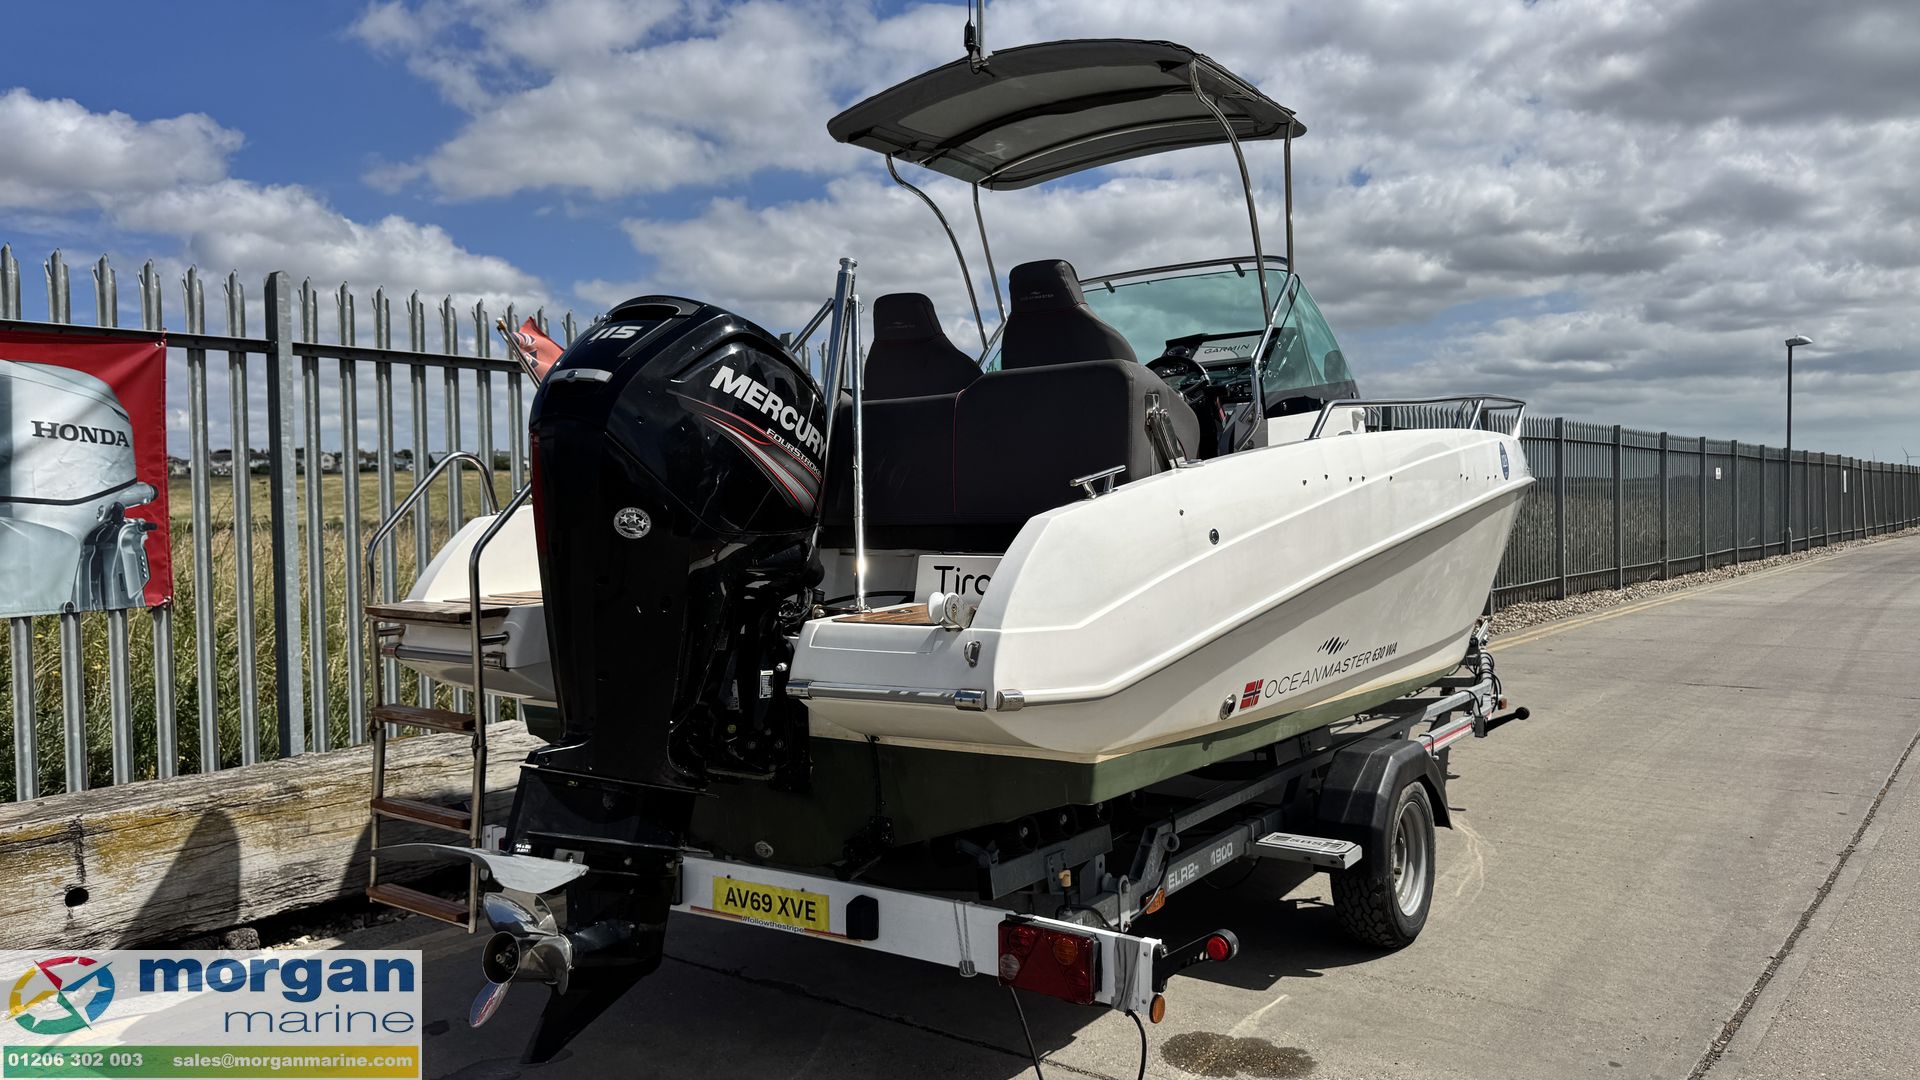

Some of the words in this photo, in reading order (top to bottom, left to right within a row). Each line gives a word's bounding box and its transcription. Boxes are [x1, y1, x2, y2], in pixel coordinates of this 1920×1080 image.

[589, 325, 643, 341] 115
[1204, 344, 1250, 354] GARMIN
[710, 365, 827, 461] MERCURY
[31, 420, 130, 448] HONDA
[1265, 651, 1370, 698] OCEANMASTER
[1372, 647, 1386, 661] 630
[1385, 642, 1398, 656] WA
[1210, 842, 1233, 865] 1900
[724, 887, 773, 913] AV69
[777, 895, 816, 921] XVE
[742, 916, 804, 933] #followthestripe
